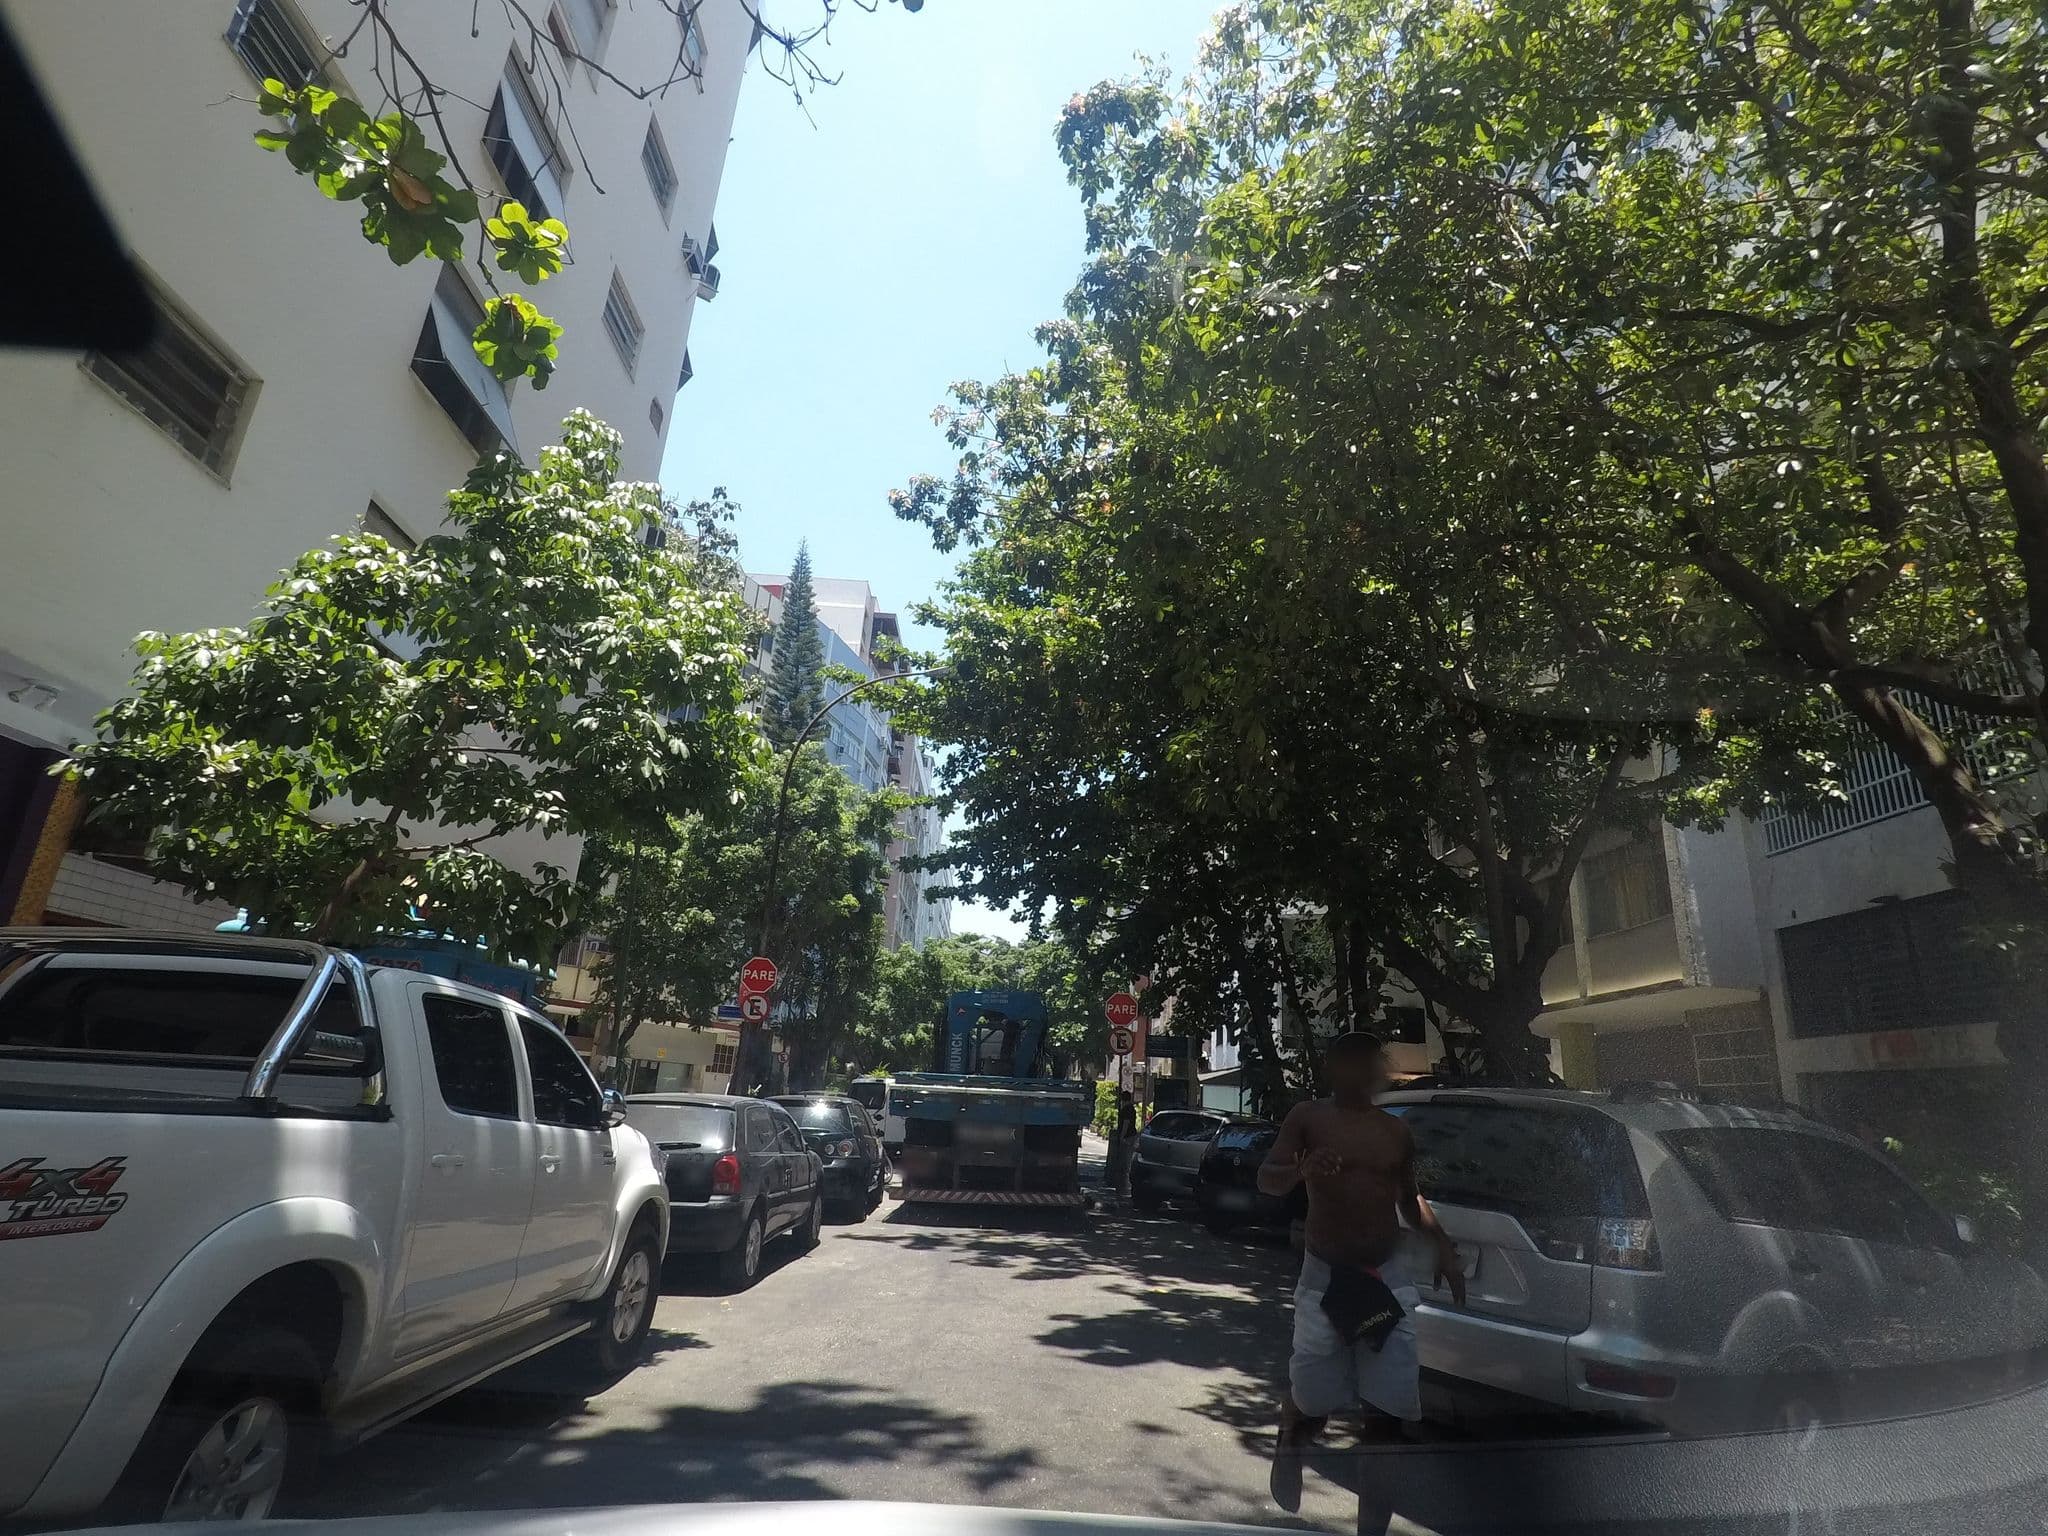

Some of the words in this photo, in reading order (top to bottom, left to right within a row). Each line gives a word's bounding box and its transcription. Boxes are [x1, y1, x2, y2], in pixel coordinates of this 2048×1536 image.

[743, 969, 775, 981] PARE
[1107, 1004, 1136, 1015] PARE
[950, 1033, 963, 1072] MUNCK
[9, 1194, 127, 1220] TURBO
